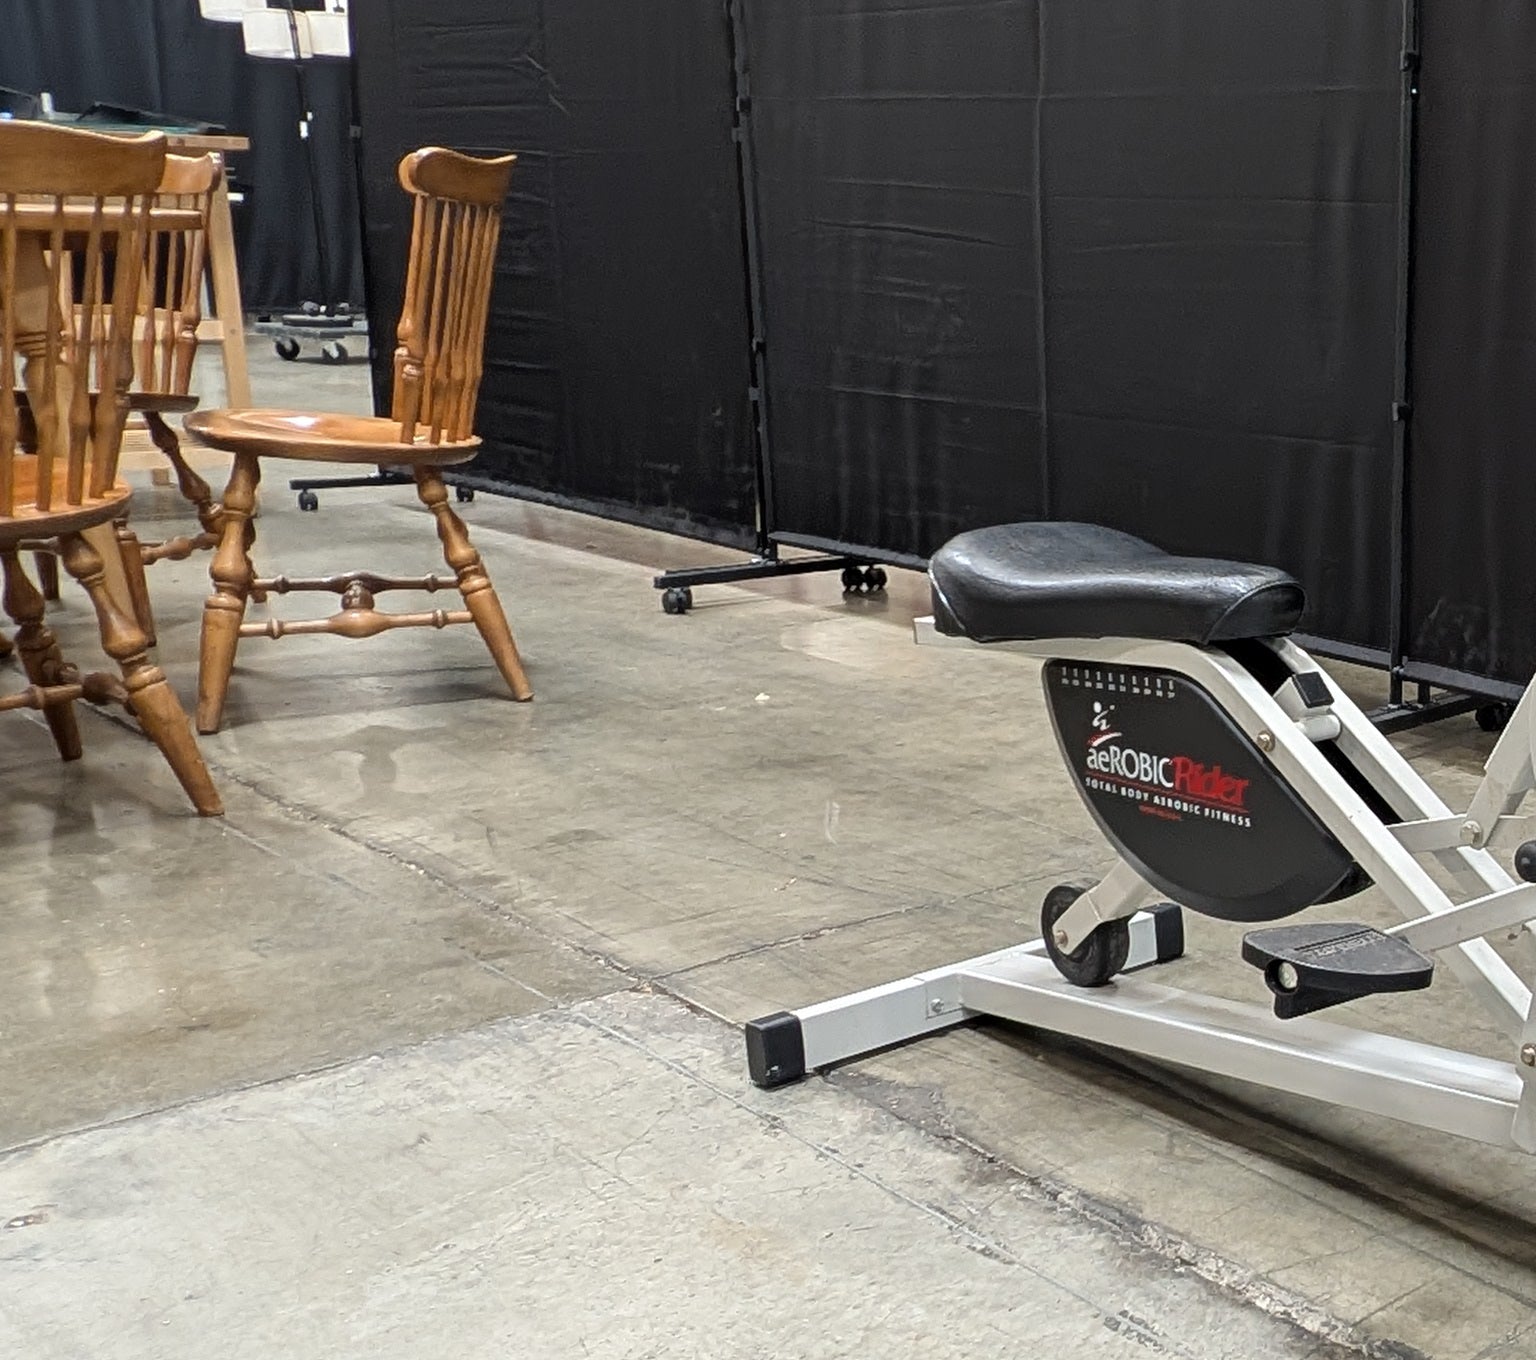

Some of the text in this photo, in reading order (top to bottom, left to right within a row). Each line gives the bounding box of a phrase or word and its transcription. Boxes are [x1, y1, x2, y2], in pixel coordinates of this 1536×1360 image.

[1085, 777, 1118, 794] TOTAL
[1120, 786, 1149, 801] BODY
[1153, 795, 1200, 814] AEROBIC
[1204, 807, 1251, 827] FITNESS
